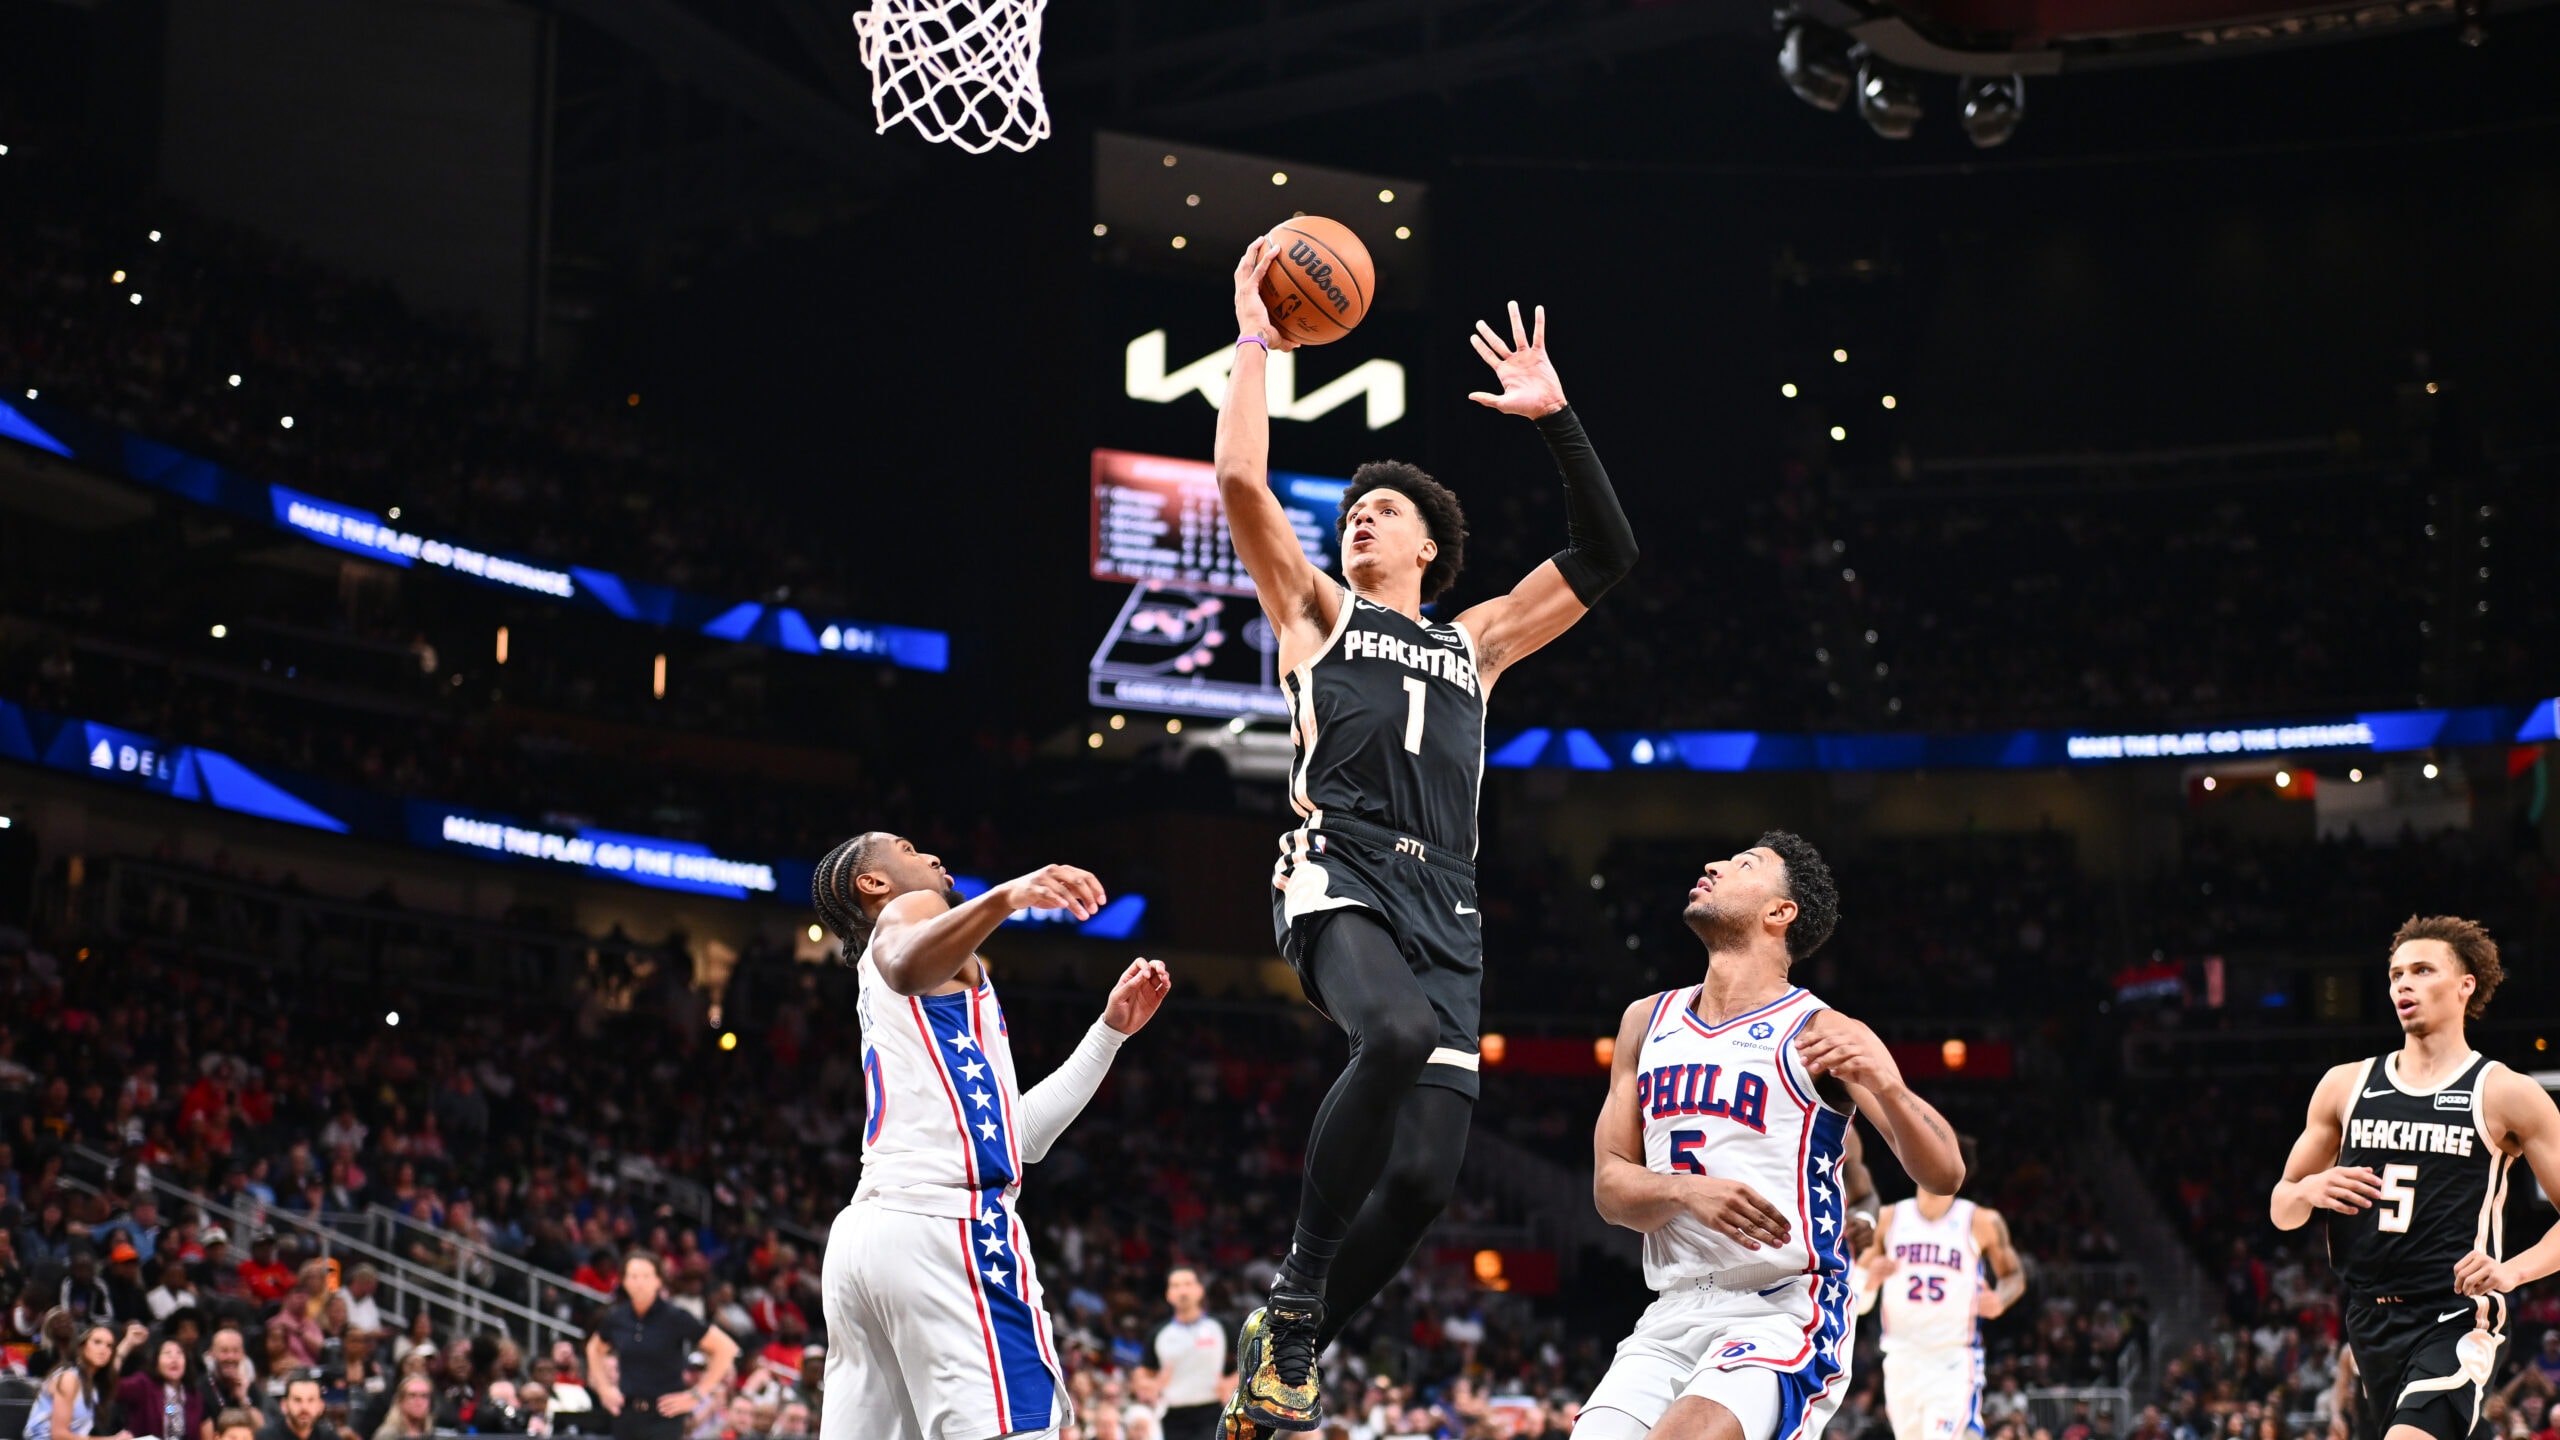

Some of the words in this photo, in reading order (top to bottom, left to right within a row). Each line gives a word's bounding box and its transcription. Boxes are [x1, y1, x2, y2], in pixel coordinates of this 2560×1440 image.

[1288, 239, 1350, 314] Wilson
[421, 540, 453, 567] GO
[1403, 676, 1427, 756] 1
[2207, 731, 2241, 753] GO
[595, 842, 633, 871] GO
[1395, 837, 1426, 862] ATL
[1638, 1063, 1768, 1135] PHILA
[2351, 1119, 2475, 1157] PEACHTREE
[2378, 1163, 2418, 1233] 5
[1895, 1243, 1961, 1271] PHILA
[1907, 1275, 1946, 1302] 25
